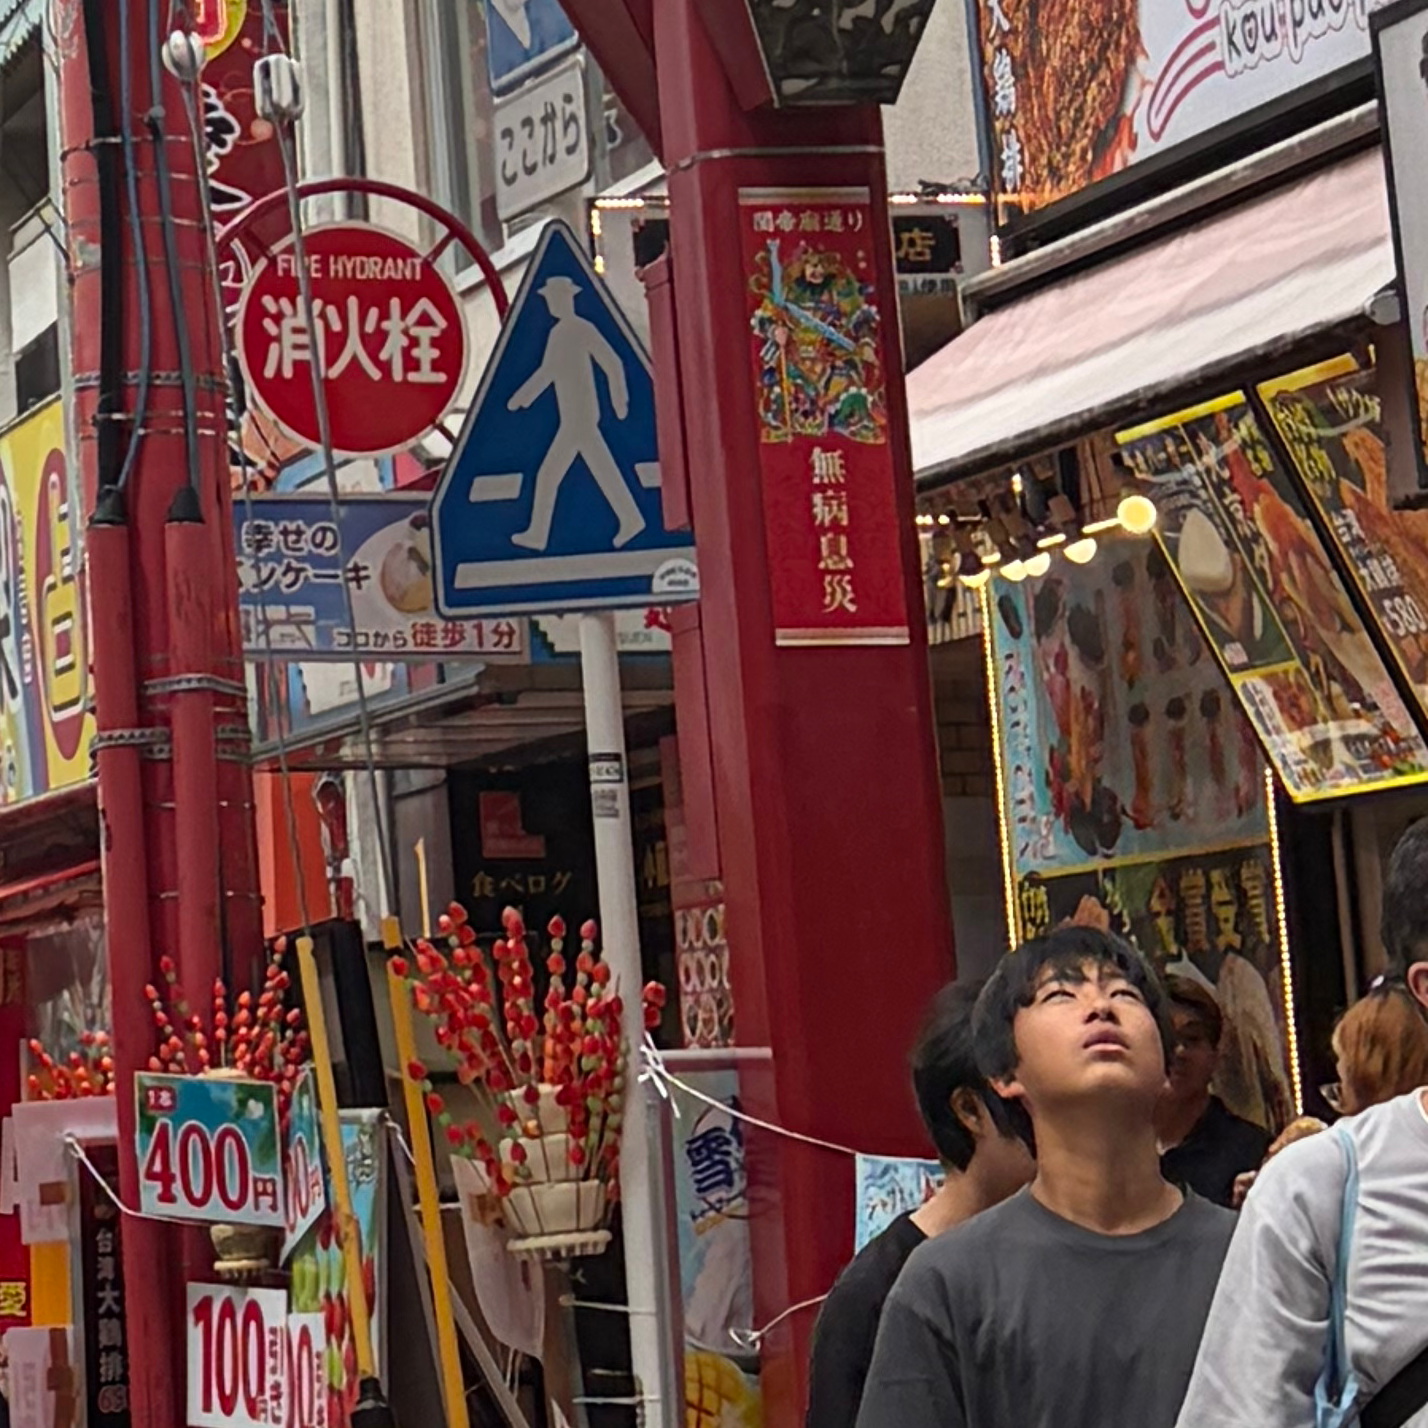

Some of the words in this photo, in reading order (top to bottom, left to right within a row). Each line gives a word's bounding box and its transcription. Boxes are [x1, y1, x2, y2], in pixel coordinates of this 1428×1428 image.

[500, 92, 580, 188] ここから
[752, 210, 864, 233] 関帝廟通り
[329, 255, 423, 281] HYDRANT
[261, 295, 449, 383] 消火栓
[243, 521, 339, 554] 幸せの
[810, 446, 858, 613] 無病息災
[471, 870, 573, 897] 食べログ
[144, 1119, 279, 1212] 400円
